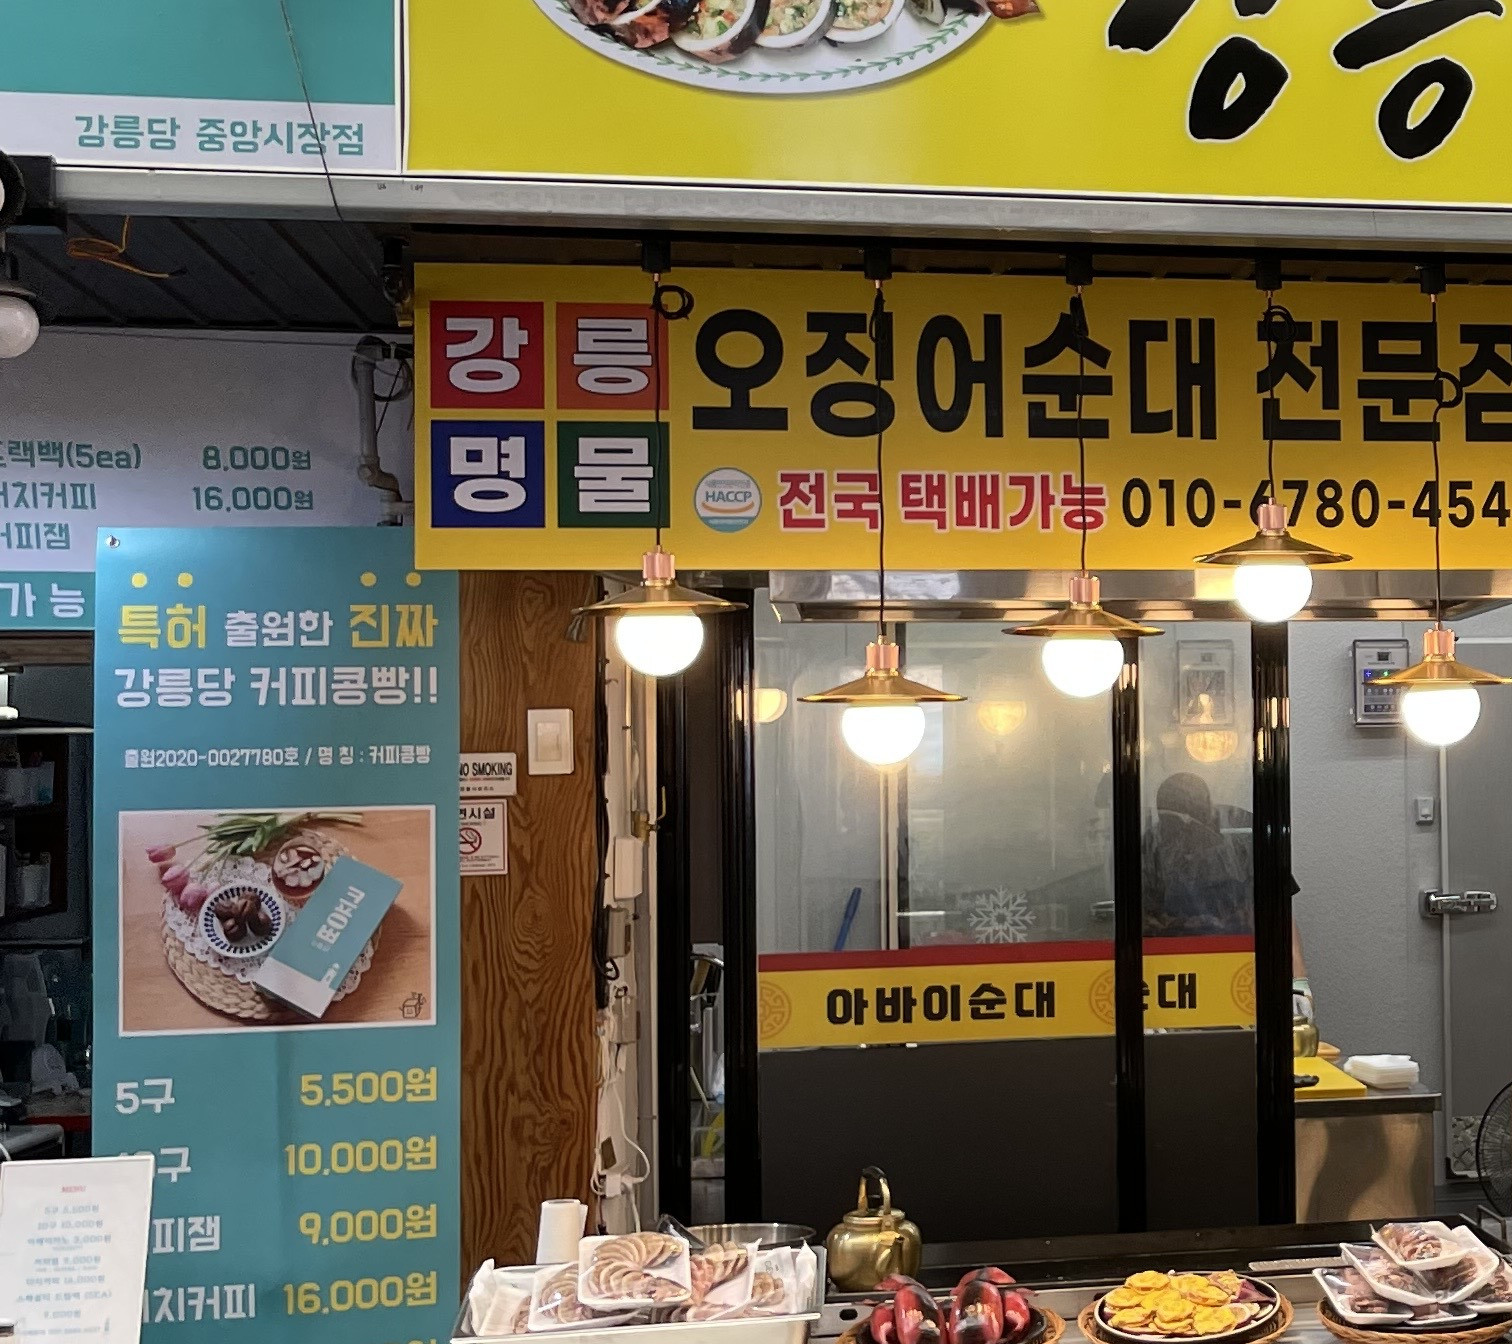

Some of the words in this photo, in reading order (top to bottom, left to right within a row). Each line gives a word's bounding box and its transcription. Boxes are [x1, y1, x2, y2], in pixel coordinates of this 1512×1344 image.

[74, 114, 181, 152] 강릉당
[195, 117, 366, 157] 중앙시장점
[445, 316, 653, 395] 강릉
[692, 309, 1217, 440] 오징어순대
[449, 435, 654, 514] 명물
[705, 490, 753, 503] HACCP
[777, 470, 881, 532] 전국
[898, 470, 1110, 533] 택배가능
[118, 604, 207, 649] 특허
[224, 611, 334, 648] 출원한
[349, 604, 439, 649] 진짜
[114, 667, 236, 708] 강릉당
[249, 666, 438, 707] 커피콩빵!!
[369, 745, 431, 765] 커피콩빵
[472, 762, 513, 777] SMOKING
[825, 979, 1056, 1027] 아바이순대
[115, 1077, 176, 1114] 5구
[151, 1213, 221, 1255] 피잼
